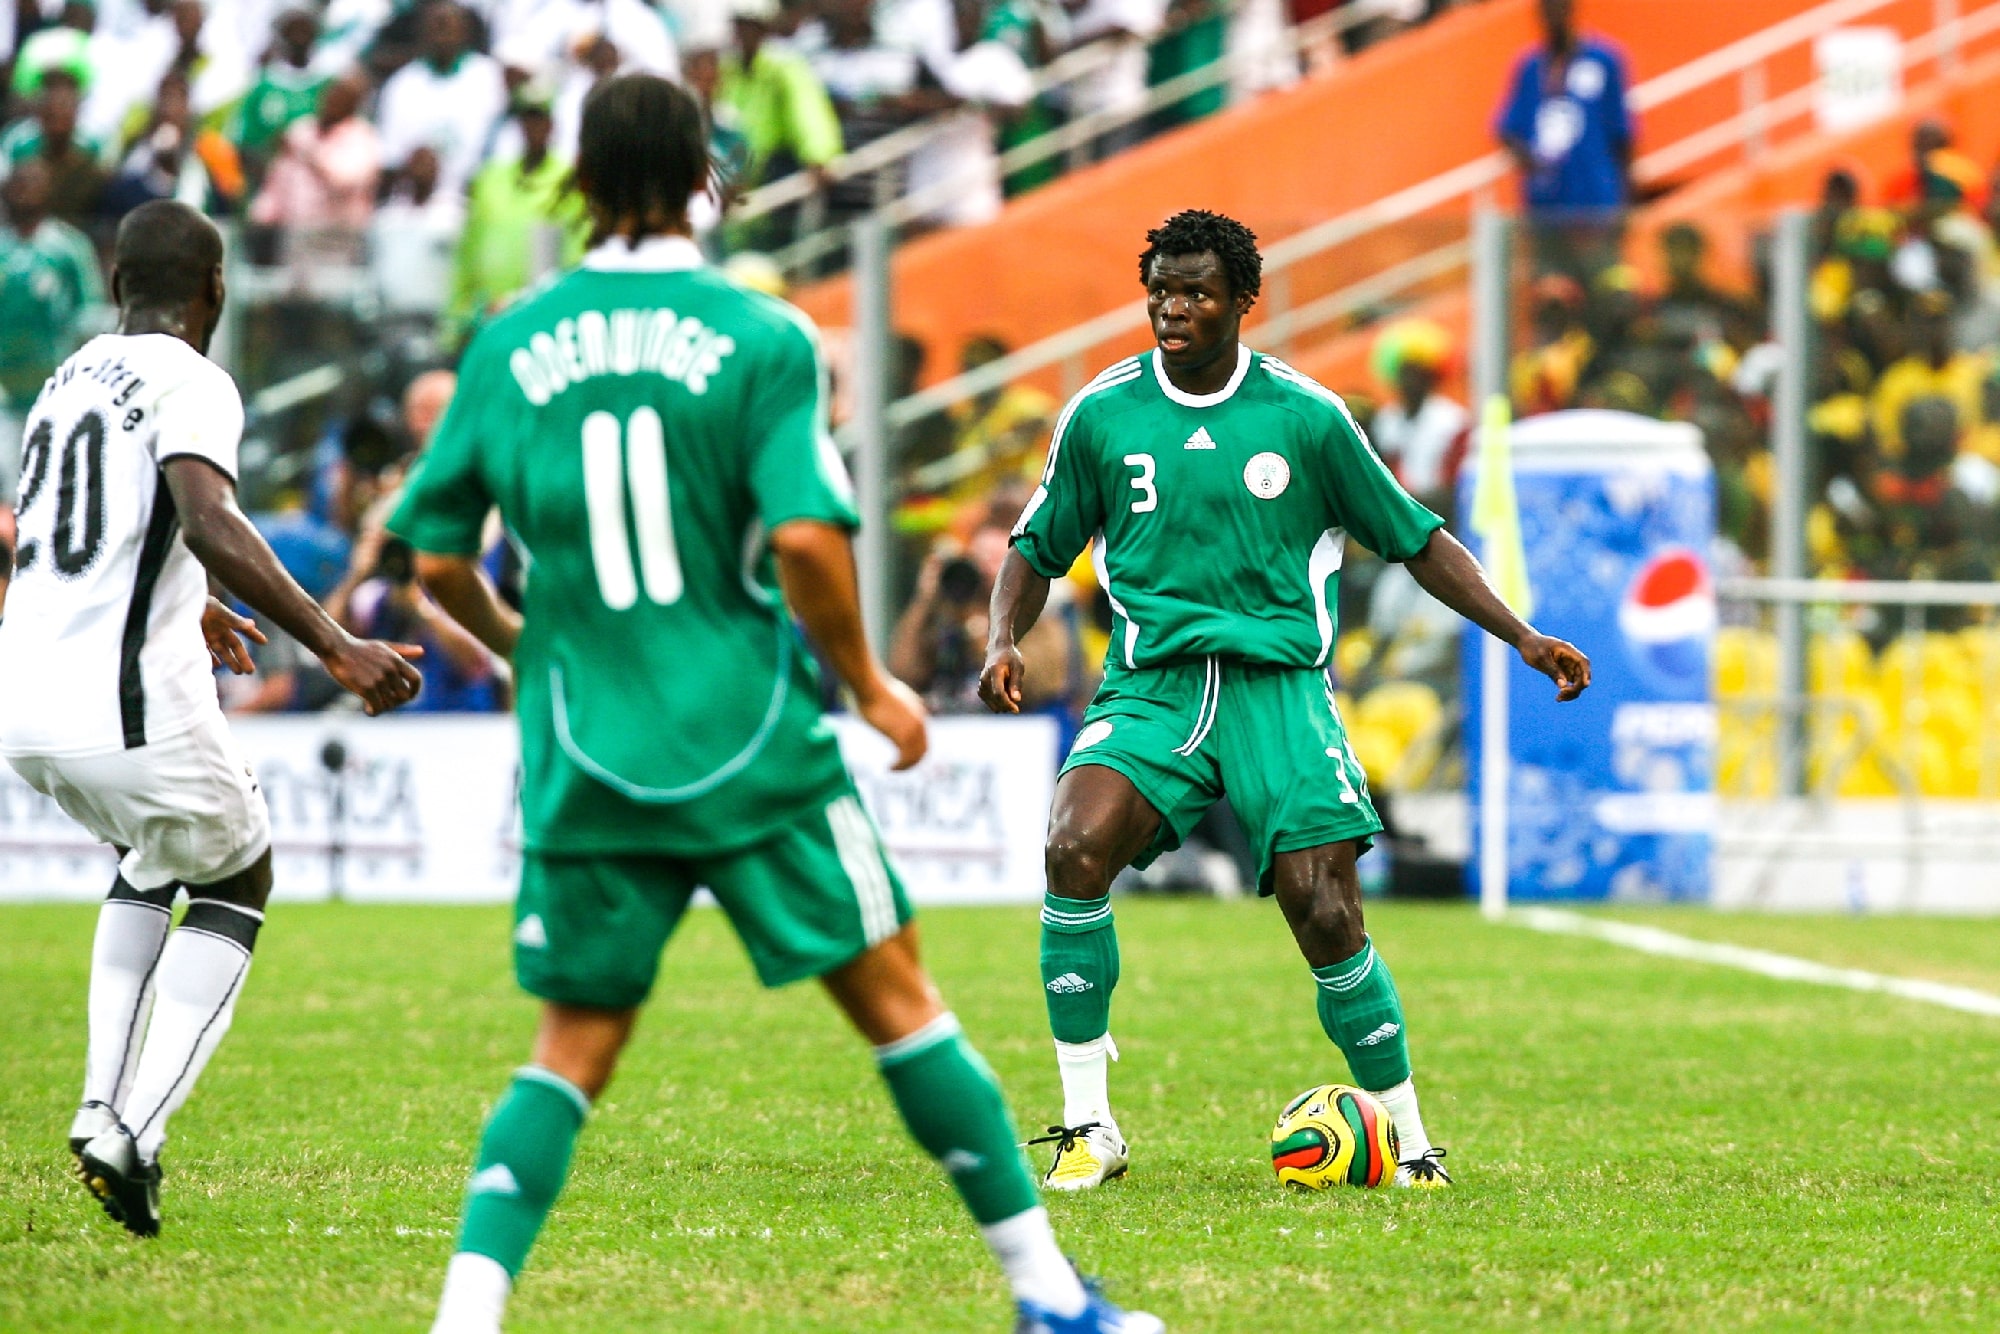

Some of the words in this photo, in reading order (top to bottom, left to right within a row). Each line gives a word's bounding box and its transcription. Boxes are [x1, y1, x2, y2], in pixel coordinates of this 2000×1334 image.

[15, 407, 110, 584] 20
[581, 405, 685, 611] 11
[1122, 452, 1158, 514] 3
